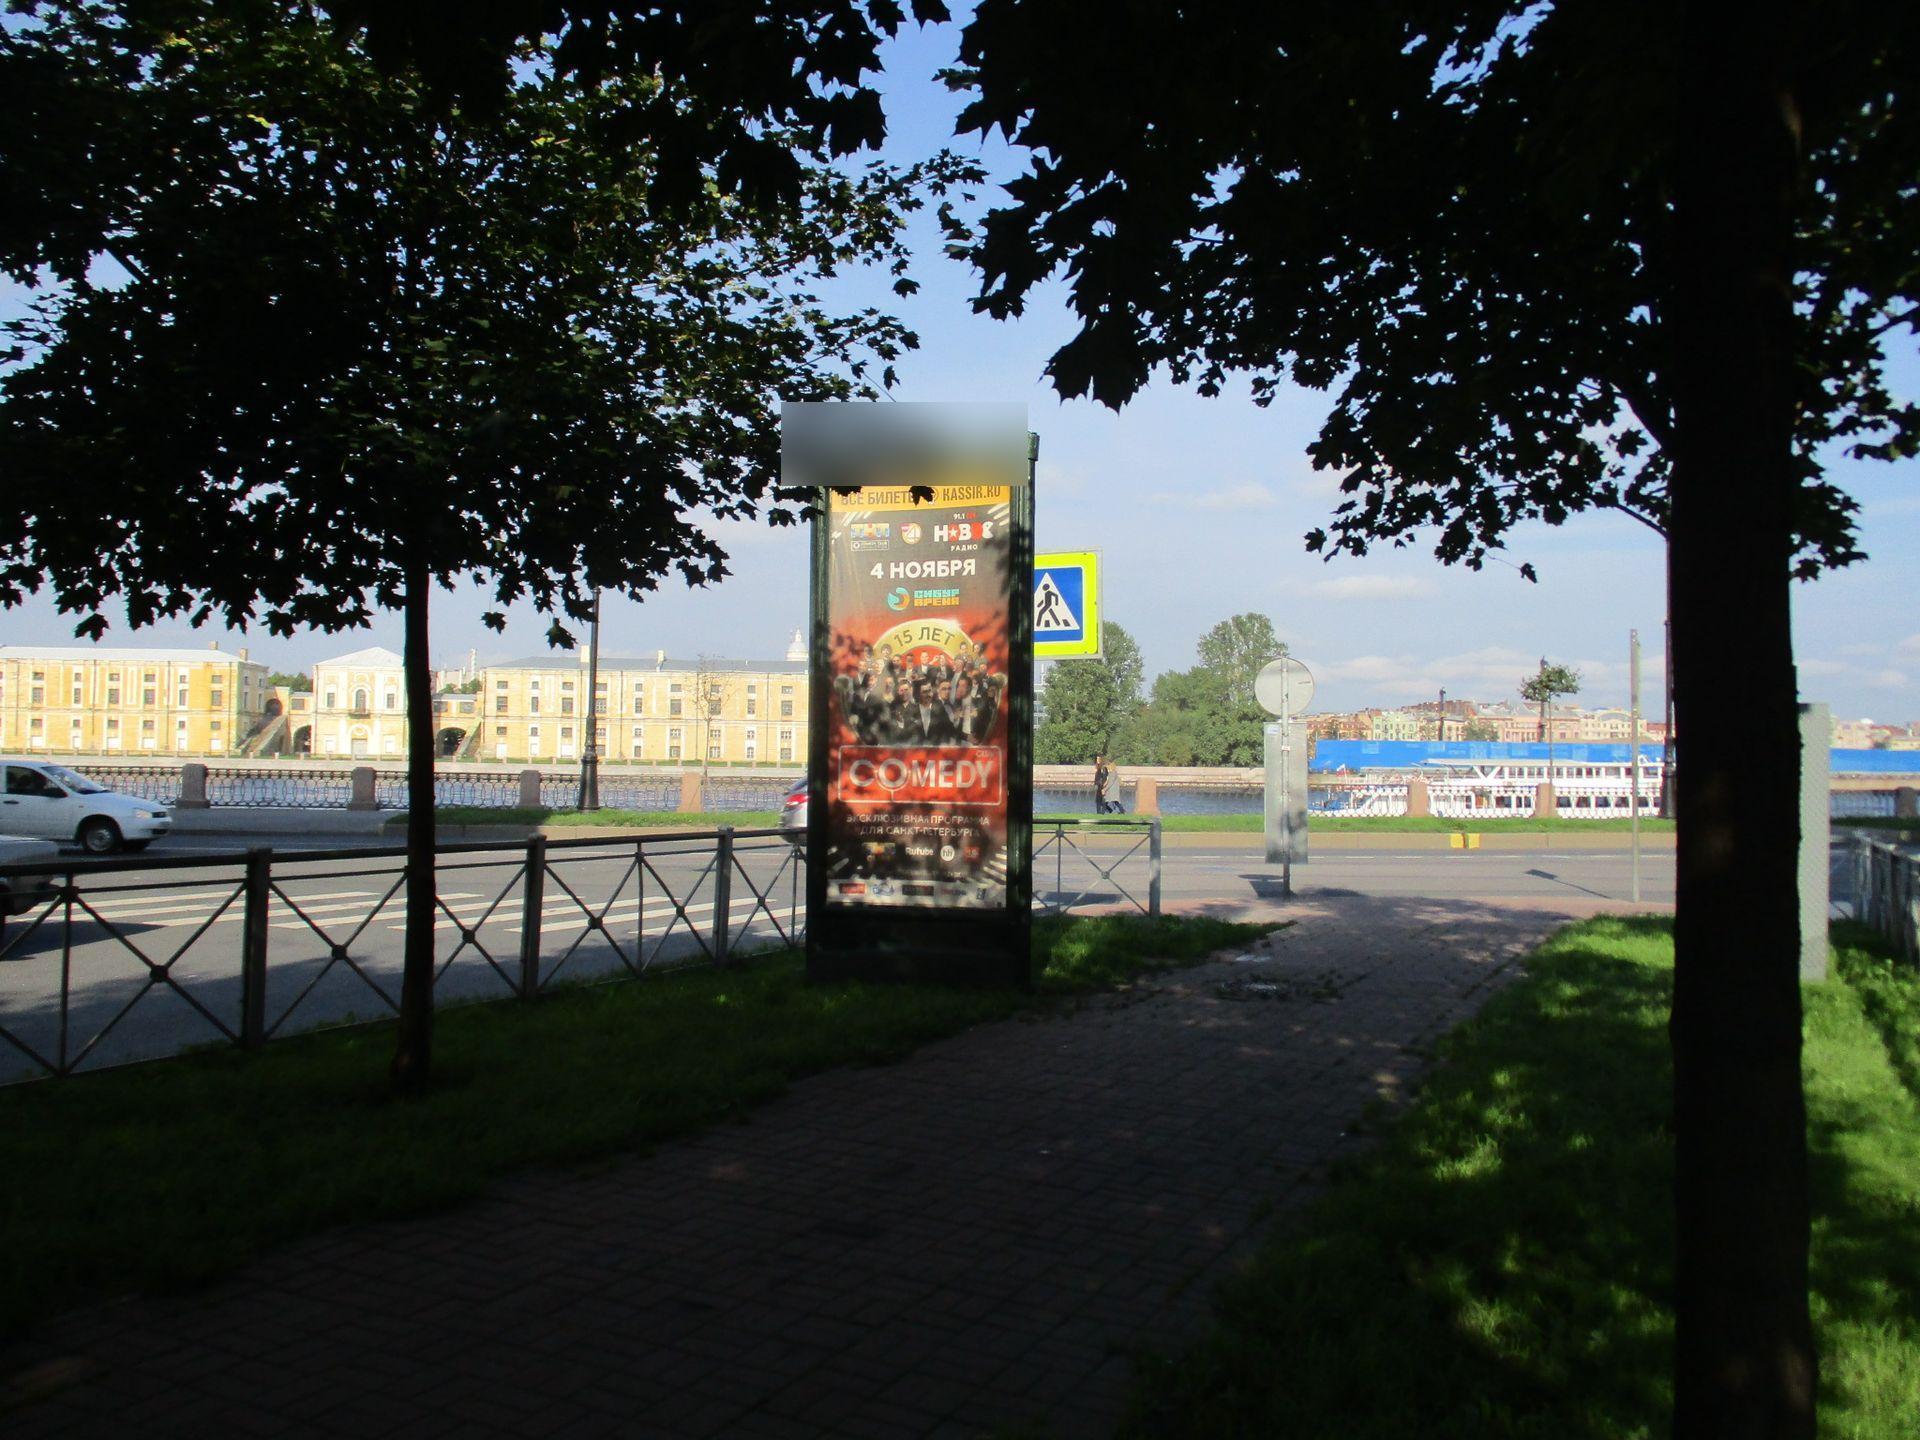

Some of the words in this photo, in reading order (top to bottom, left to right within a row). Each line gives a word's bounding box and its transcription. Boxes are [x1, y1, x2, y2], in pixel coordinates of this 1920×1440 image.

[870, 562, 884, 579] 4
[890, 559, 976, 579] НОЯБРЯ
[894, 629, 913, 647] 15
[918, 626, 956, 646] ЛЕТ
[850, 758, 994, 789] COMEDY
